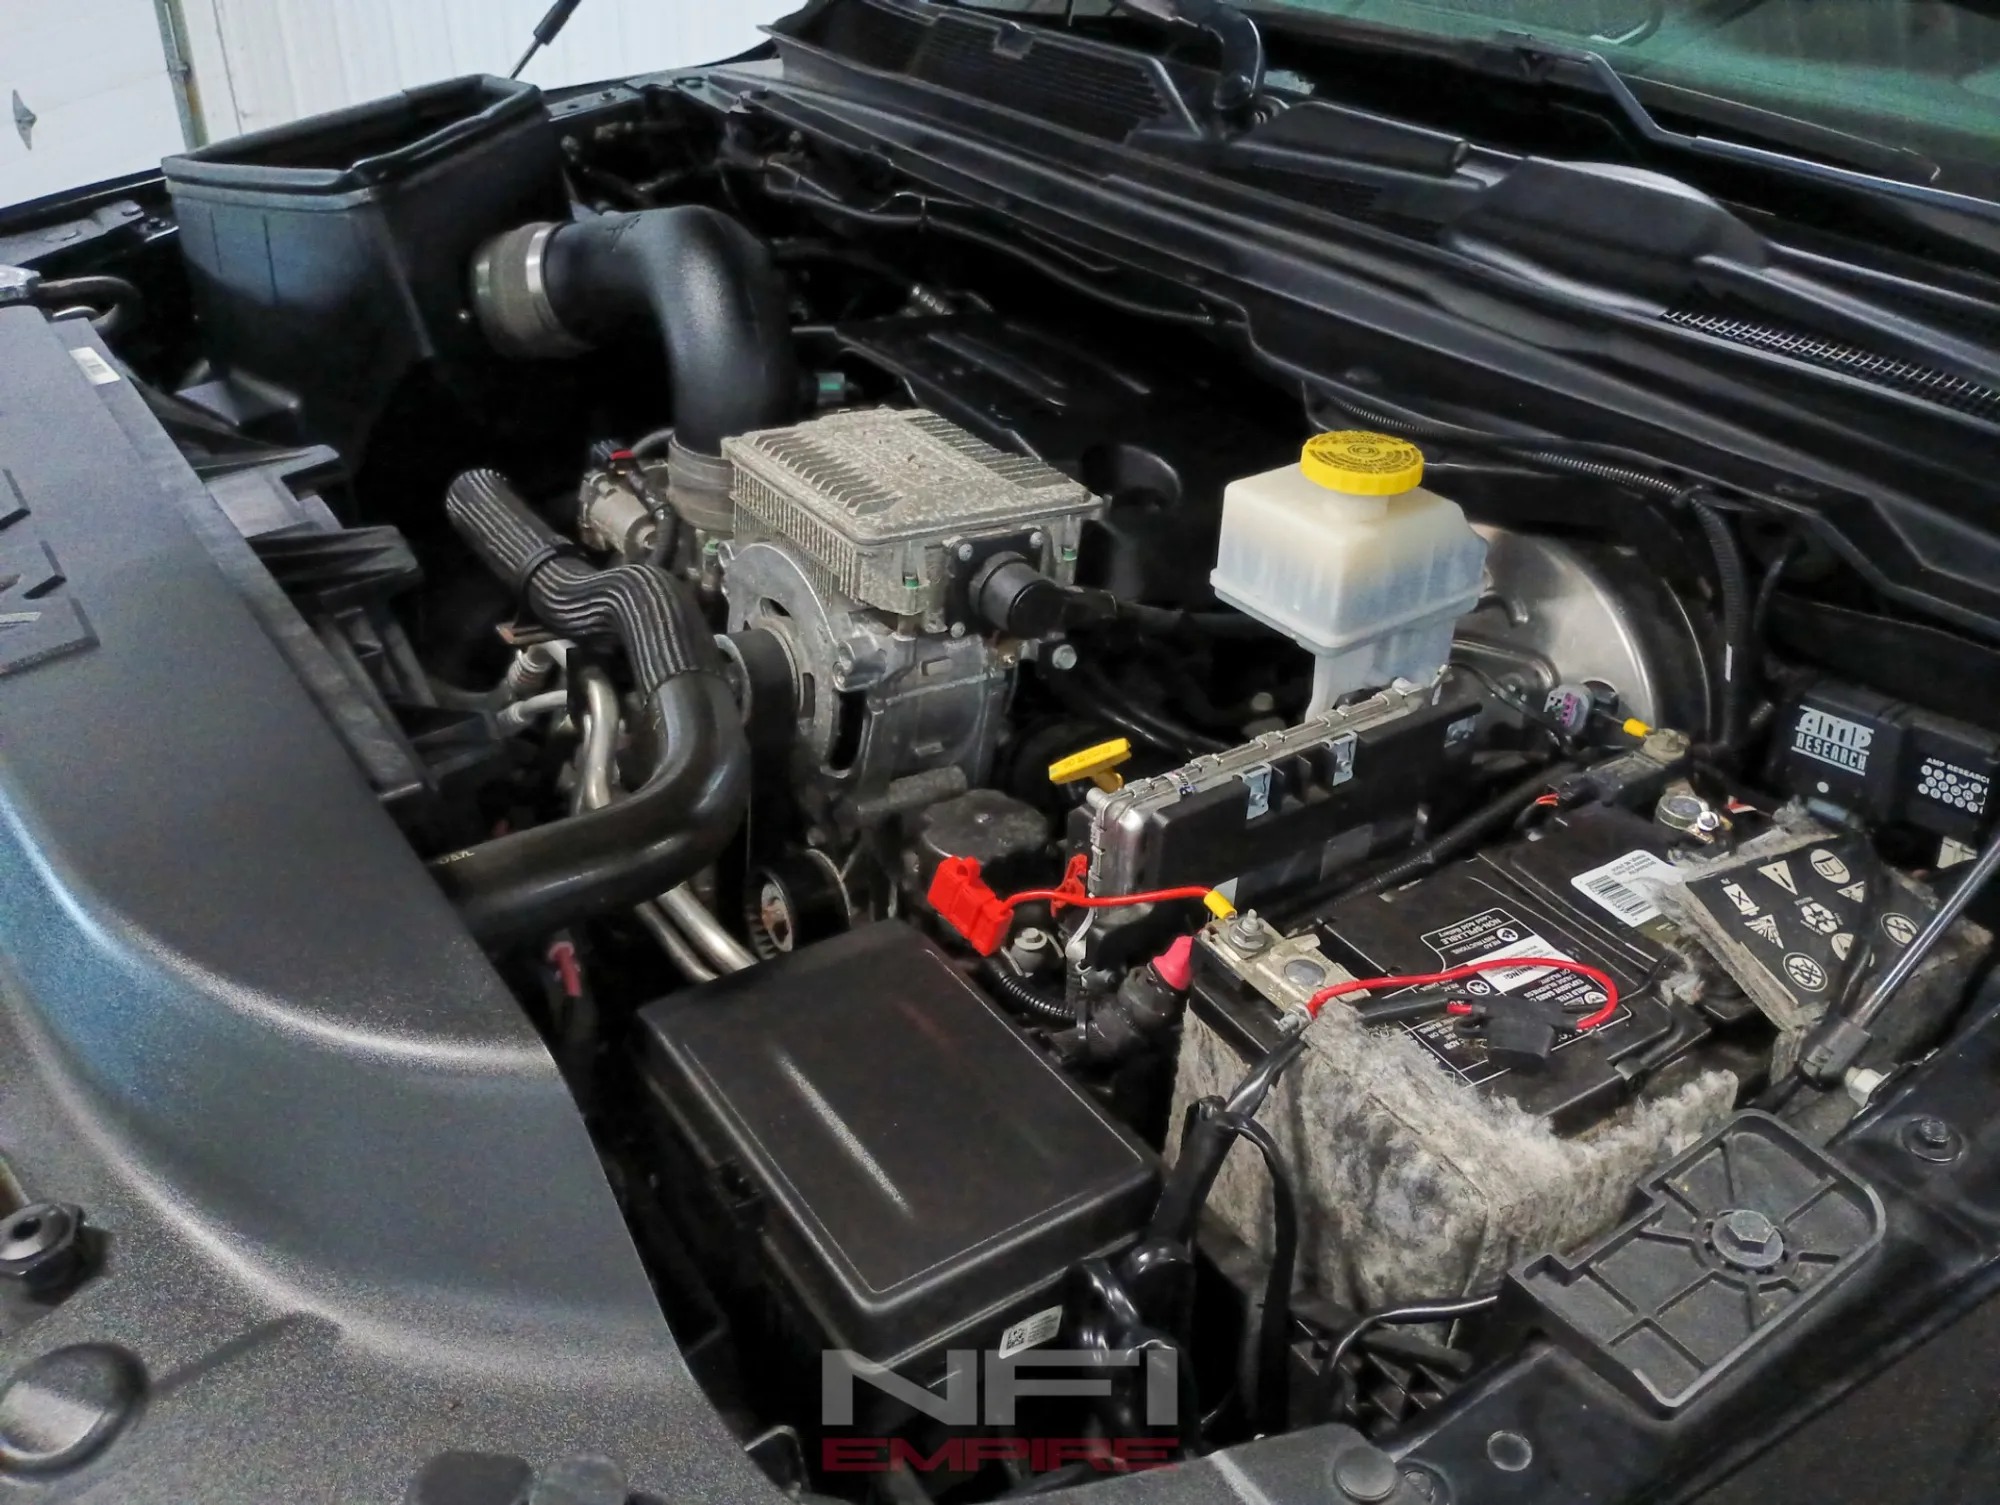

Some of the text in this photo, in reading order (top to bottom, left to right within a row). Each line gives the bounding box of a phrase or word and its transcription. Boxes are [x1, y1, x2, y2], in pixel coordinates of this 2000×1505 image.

[1796, 704, 1874, 756] AMP
[1795, 732, 1867, 771] RESEARCH
[1926, 757, 1945, 767] AMP
[1475, 915, 1492, 924] Lead
[1460, 921, 1476, 930] Acid
[1440, 918, 1502, 945] NON-SPILLABLE
[1483, 940, 1501, 950] READ
